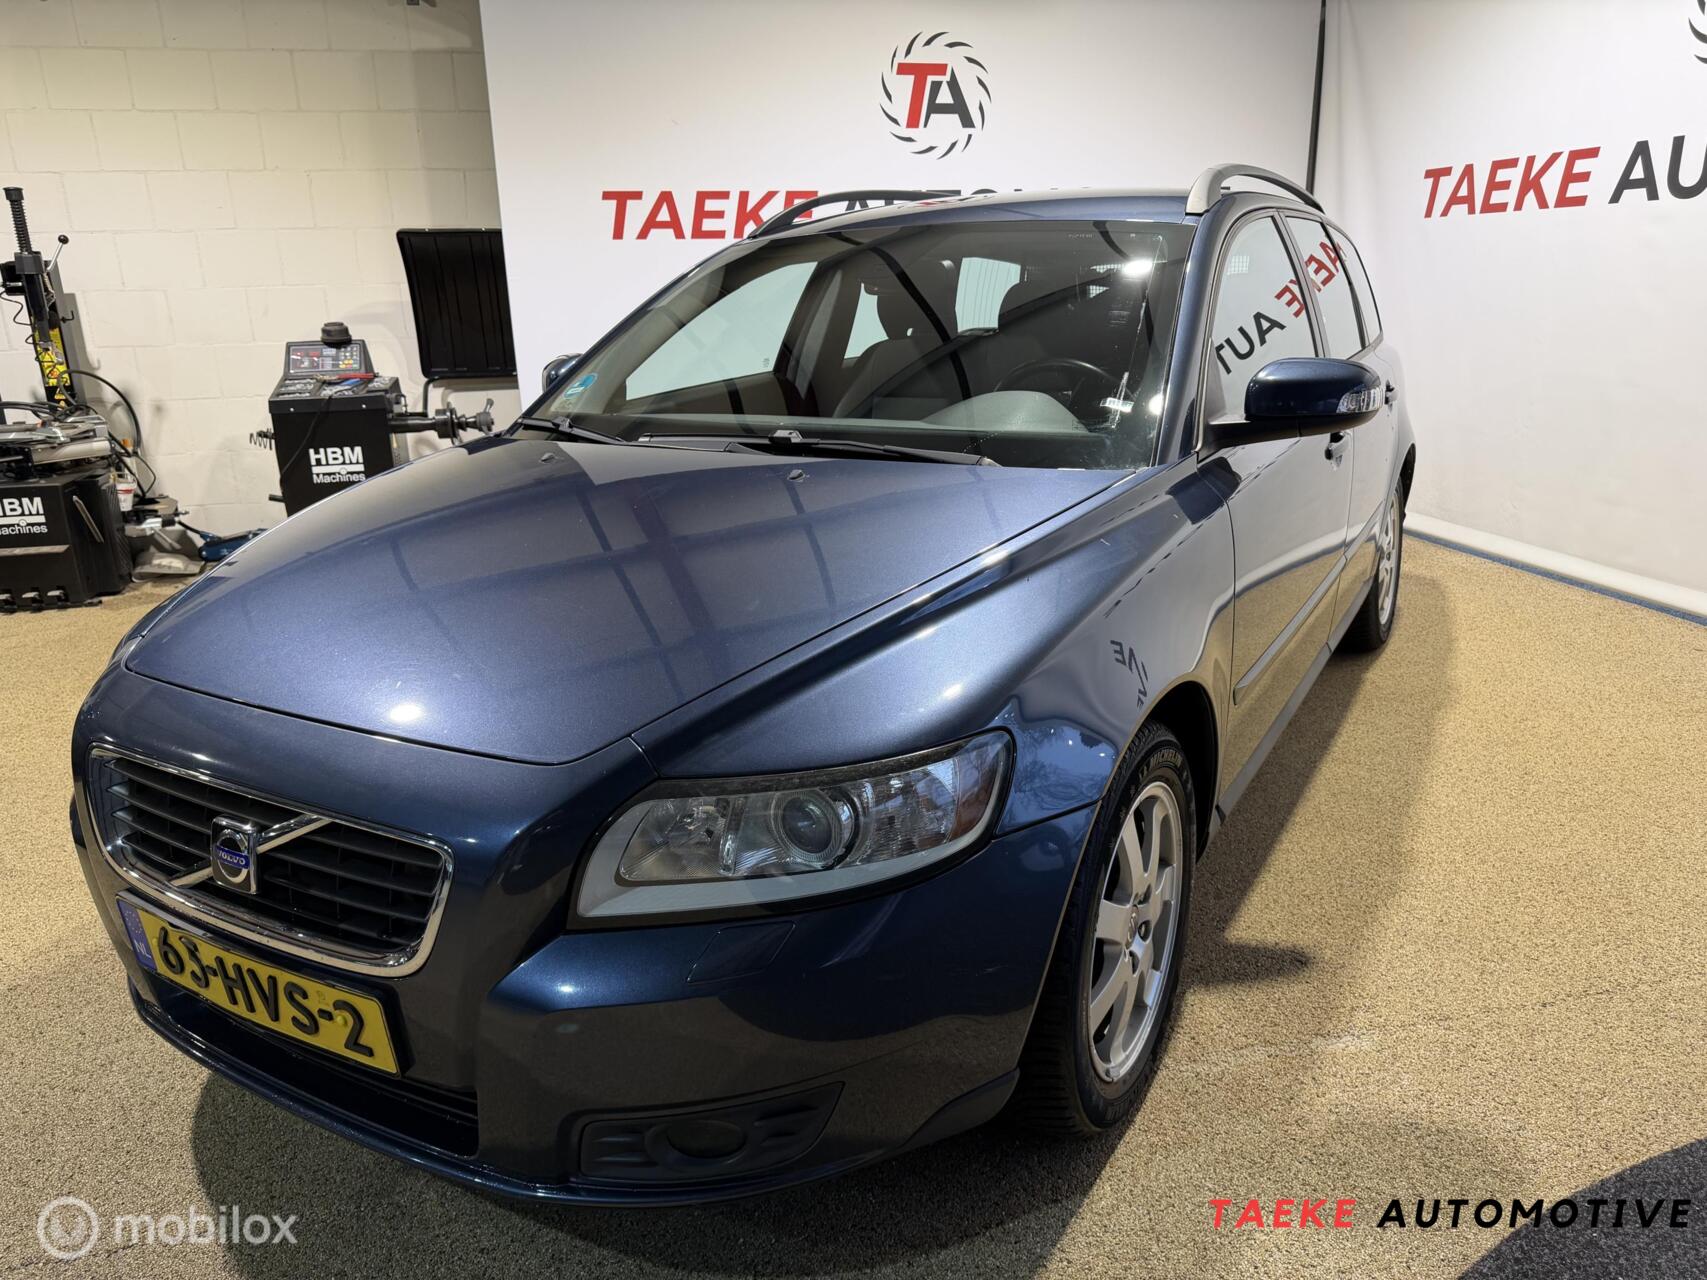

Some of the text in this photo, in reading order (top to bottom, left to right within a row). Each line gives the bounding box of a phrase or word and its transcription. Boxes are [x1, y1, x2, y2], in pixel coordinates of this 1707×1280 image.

[896, 62, 976, 129] TA
[1423, 146, 1601, 219] TAEKE
[308, 446, 364, 466] HBM
[312, 473, 366, 484] Machines
[0, 524, 48, 536] achines
[217, 849, 246, 865] VOLVO
[134, 939, 152, 959] NL
[157, 926, 375, 1058] 63-HVS-2
